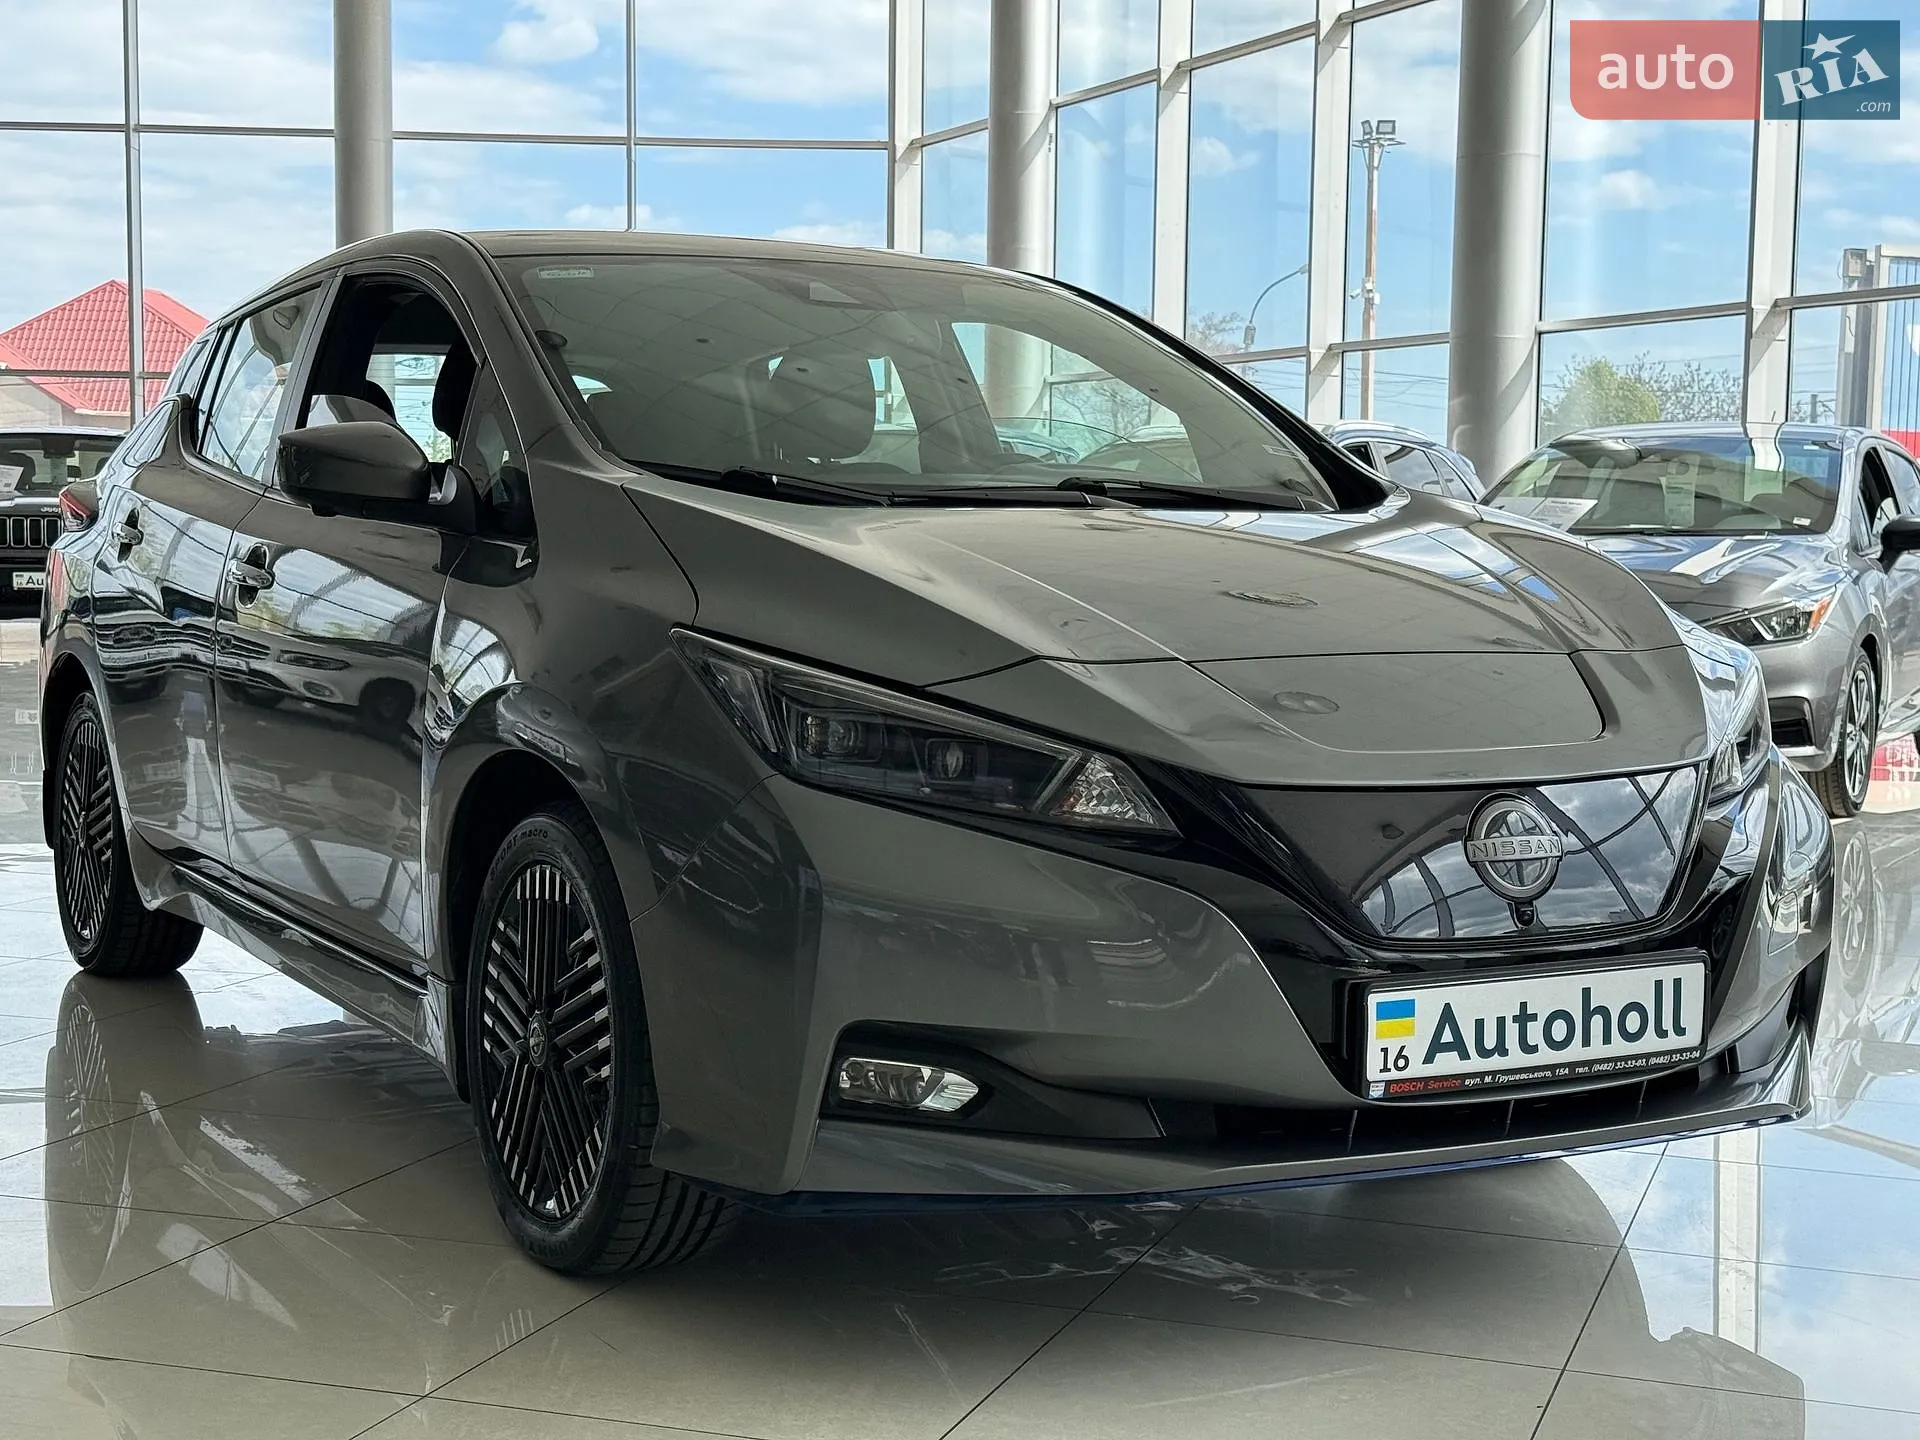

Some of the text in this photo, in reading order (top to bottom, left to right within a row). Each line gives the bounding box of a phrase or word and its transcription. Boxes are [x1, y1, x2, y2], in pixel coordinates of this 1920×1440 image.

[1469, 838, 1561, 858] NISSAN
[1378, 977, 1687, 1074] 16 Autoholl
[1389, 1081, 1425, 1093] BOSCH
[1427, 1079, 1462, 1090] Service
[1464, 1077, 1482, 1086] вул.
[1495, 1069, 1553, 1084] Грушевського,
[1575, 1066, 1590, 1074] тел.
[1591, 1061, 1615, 1073] (0482)
[1615, 1059, 1646, 1070] 33-33-03,
[1647, 1056, 1671, 1068] (0482)
